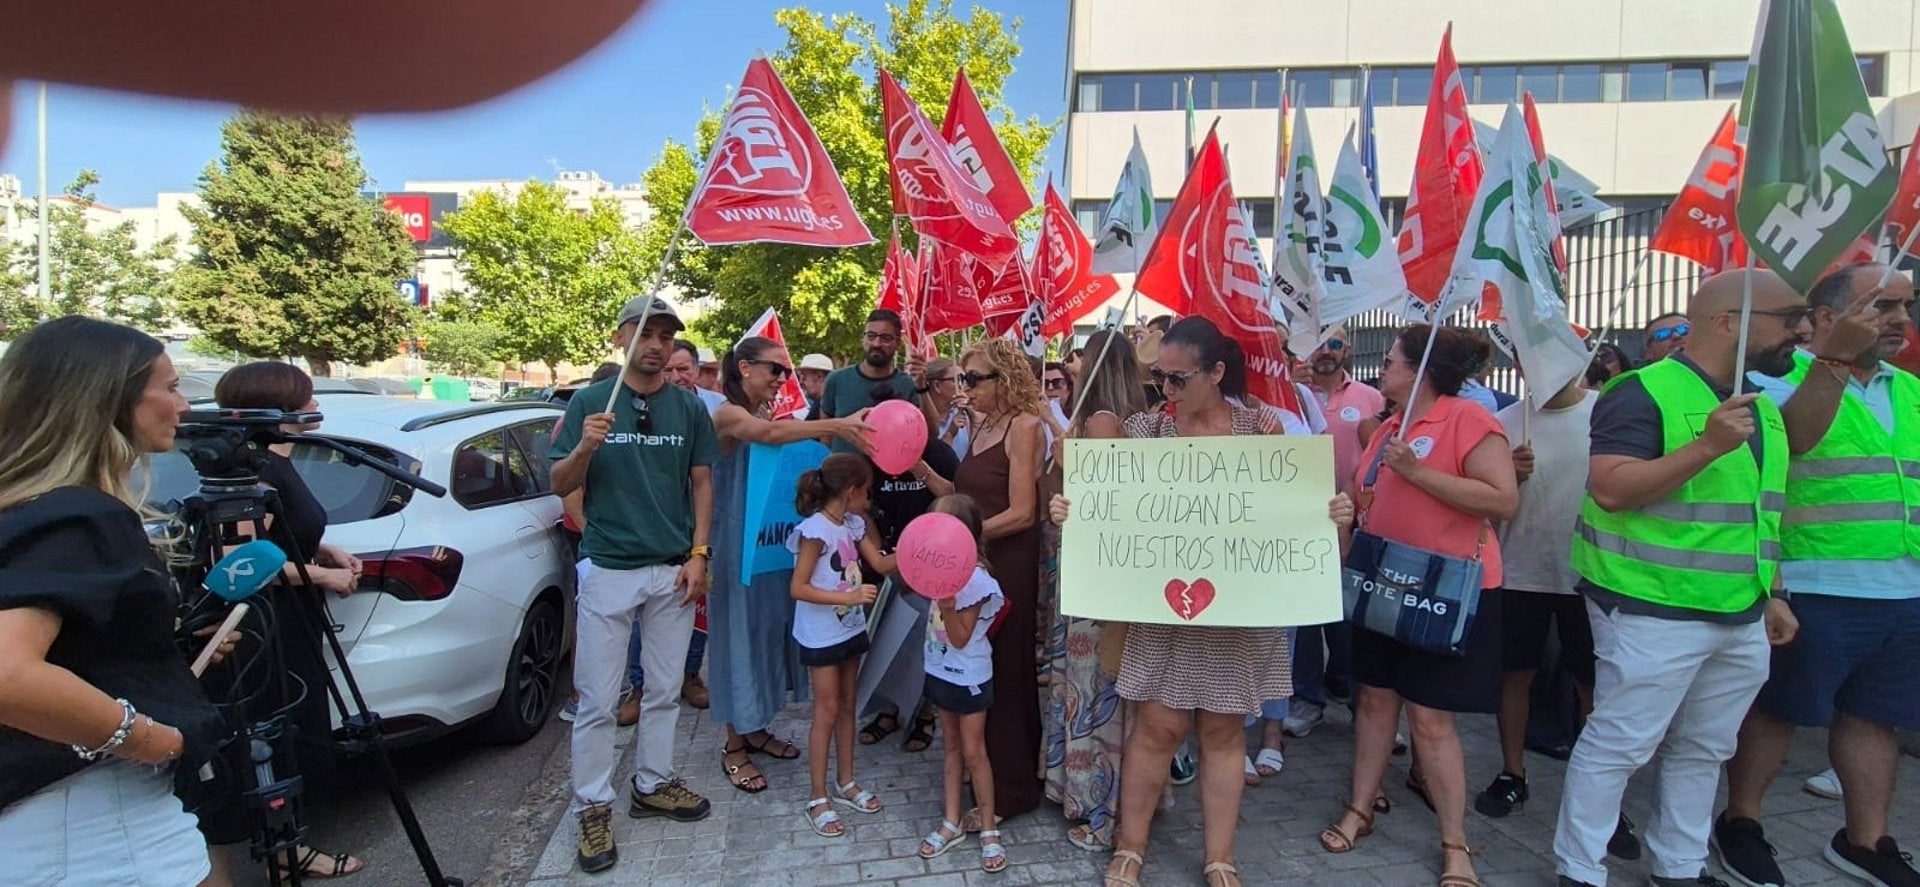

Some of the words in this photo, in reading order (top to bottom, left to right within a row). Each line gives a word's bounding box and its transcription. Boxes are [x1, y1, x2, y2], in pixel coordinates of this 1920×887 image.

[727, 94, 802, 178] UGT
[715, 206, 844, 231] www.ugt.es
[1021, 304, 1046, 347] CSI
[605, 431, 685, 447] carhartt
[1068, 442, 1145, 485] ¿QUIEN
[1157, 443, 1229, 484] CUIDA
[1235, 450, 1253, 483] A
[1259, 447, 1298, 484] LOS
[1079, 489, 1122, 523] QUE
[1135, 486, 1220, 526] CUIDAN
[1228, 491, 1258, 524] DE
[1098, 532, 1216, 571] NUESTROS
[1224, 537, 1333, 575] MAYORES?
[1352, 575, 1397, 601] TOTE
[1403, 593, 1447, 615] BAG
[1383, 568, 1421, 590] THE
